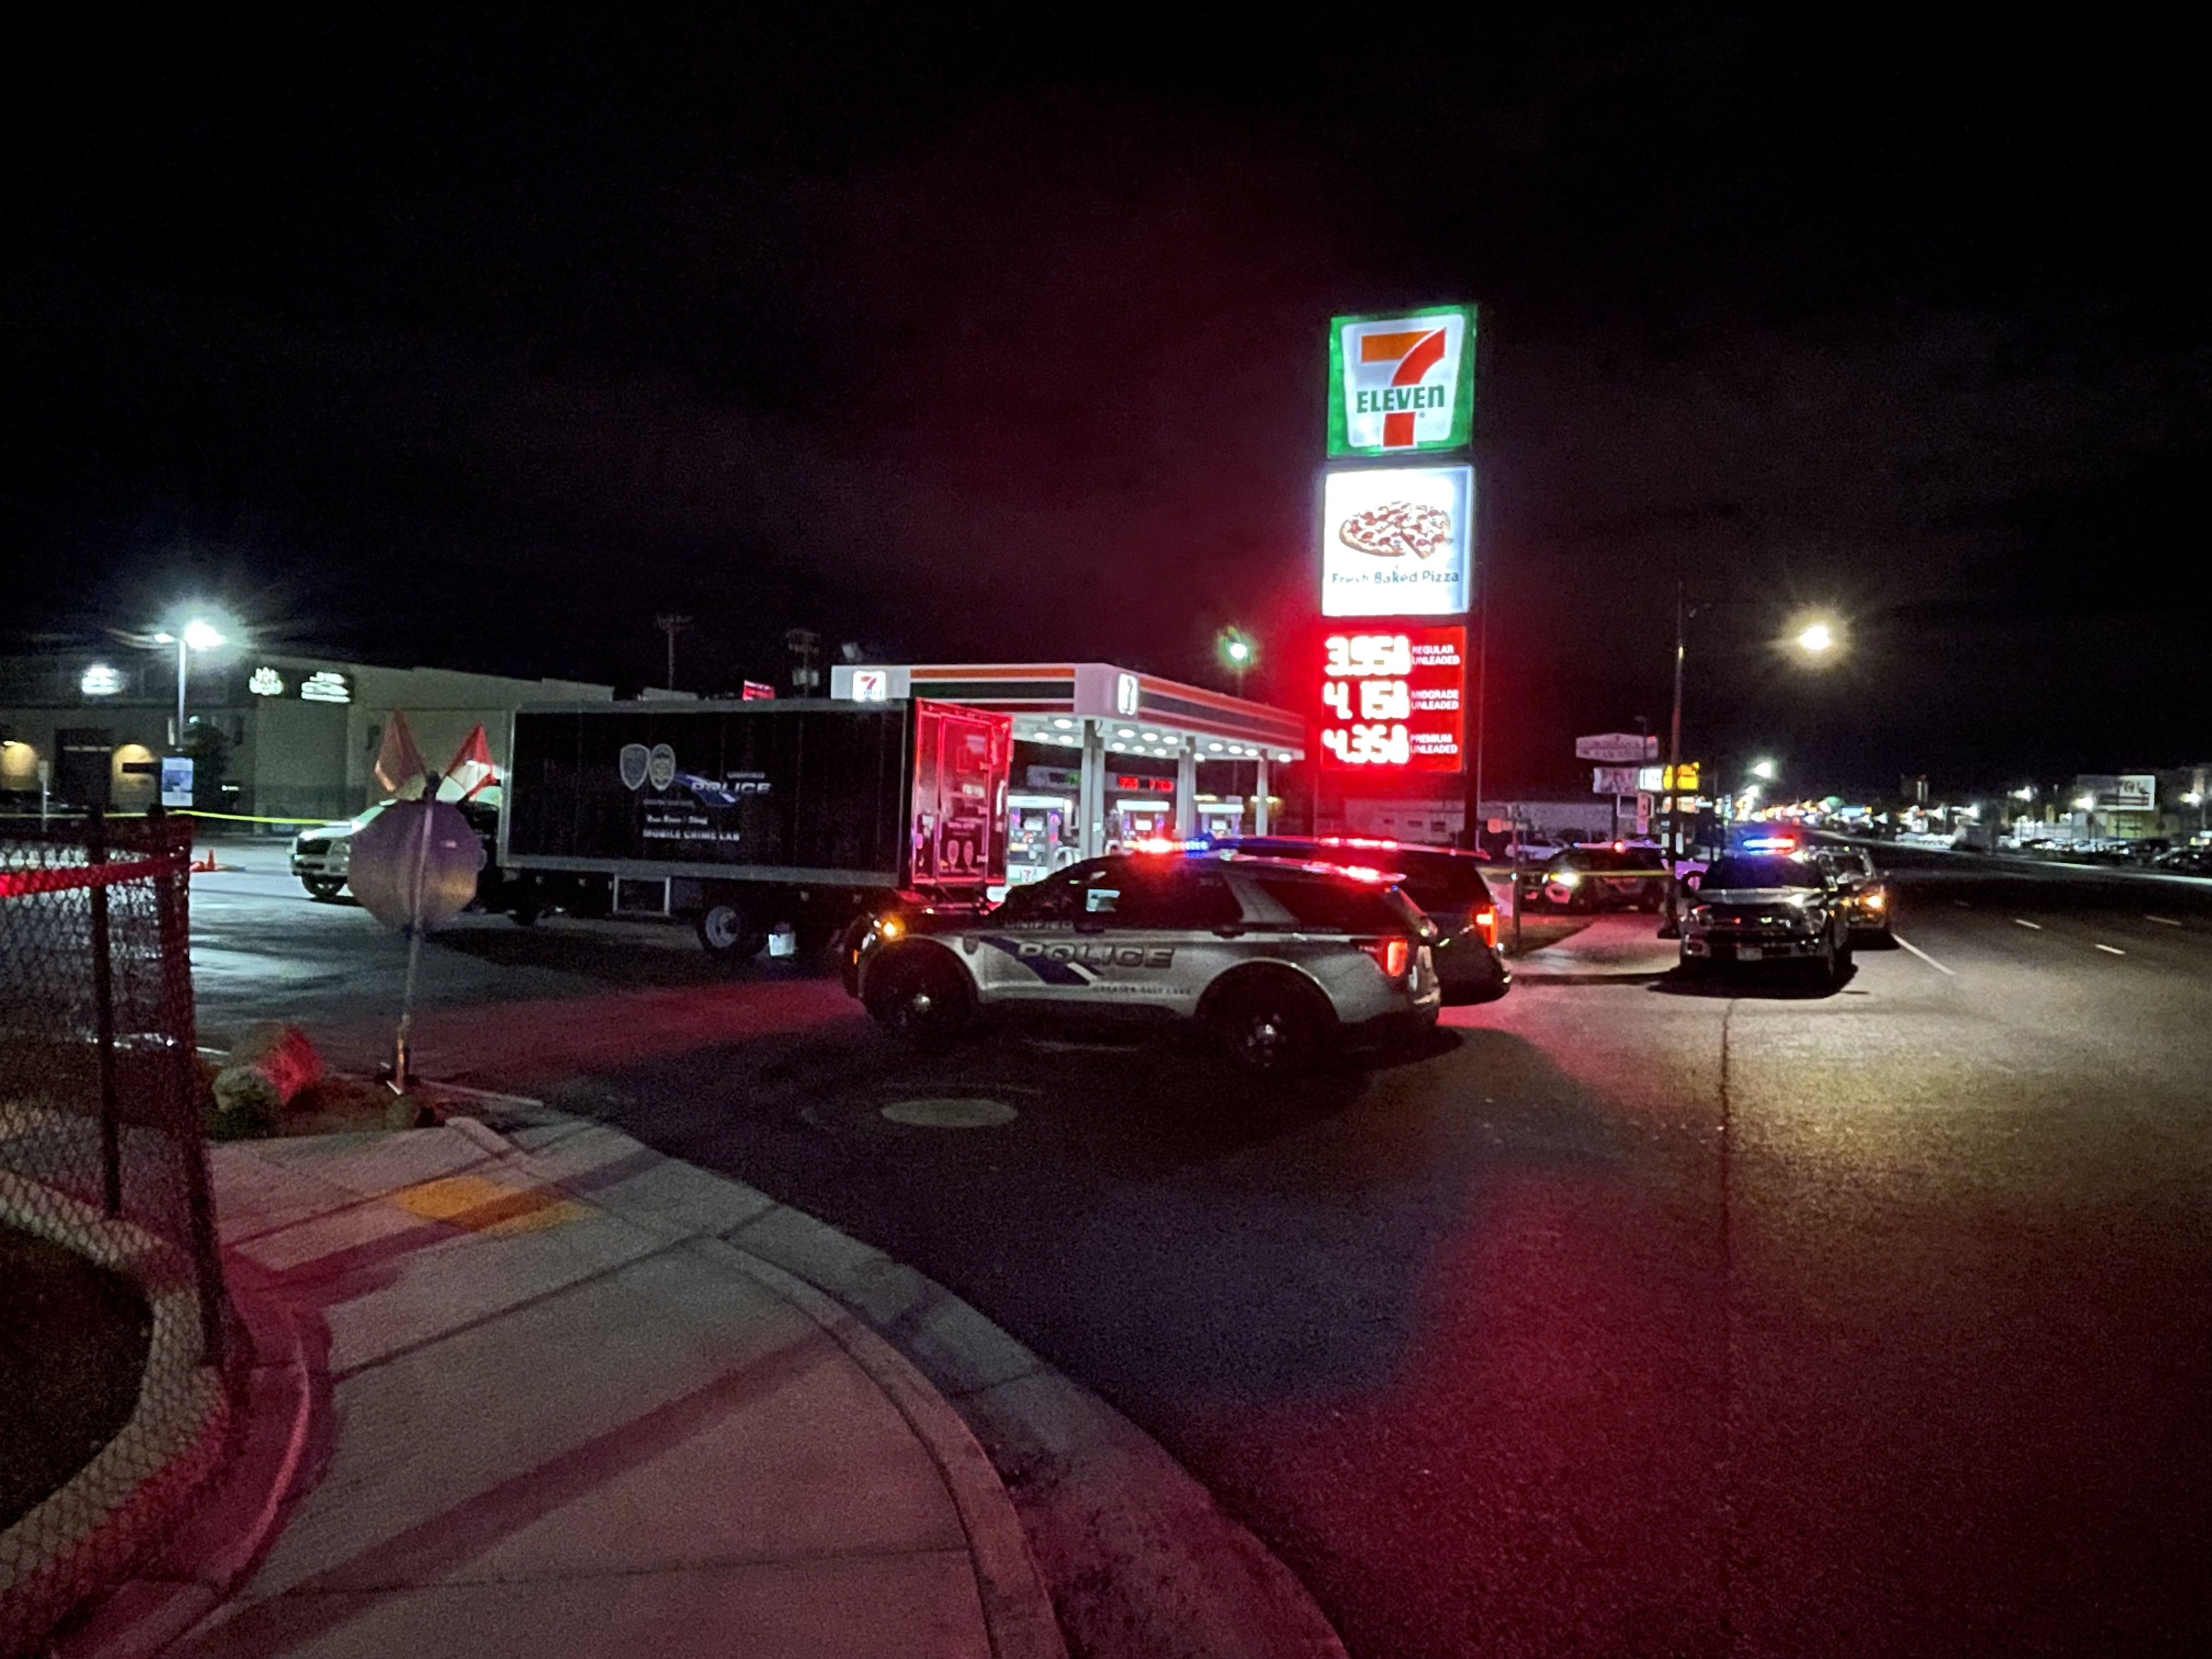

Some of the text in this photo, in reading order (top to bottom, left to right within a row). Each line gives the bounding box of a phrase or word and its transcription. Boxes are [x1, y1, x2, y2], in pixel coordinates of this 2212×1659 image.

[1374, 570, 1418, 584] Baked
[1422, 570, 1459, 583] Pizza
[1412, 645, 1454, 653] REGULAR
[1412, 655, 1460, 665] UNLEADED
[1411, 700, 1459, 709] UNLEADED
[1410, 733, 1453, 743] PREMIUM
[1410, 744, 1458, 754] UNLEADED
[691, 781, 771, 793] POLICE
[1017, 940, 1176, 969] POLICE
